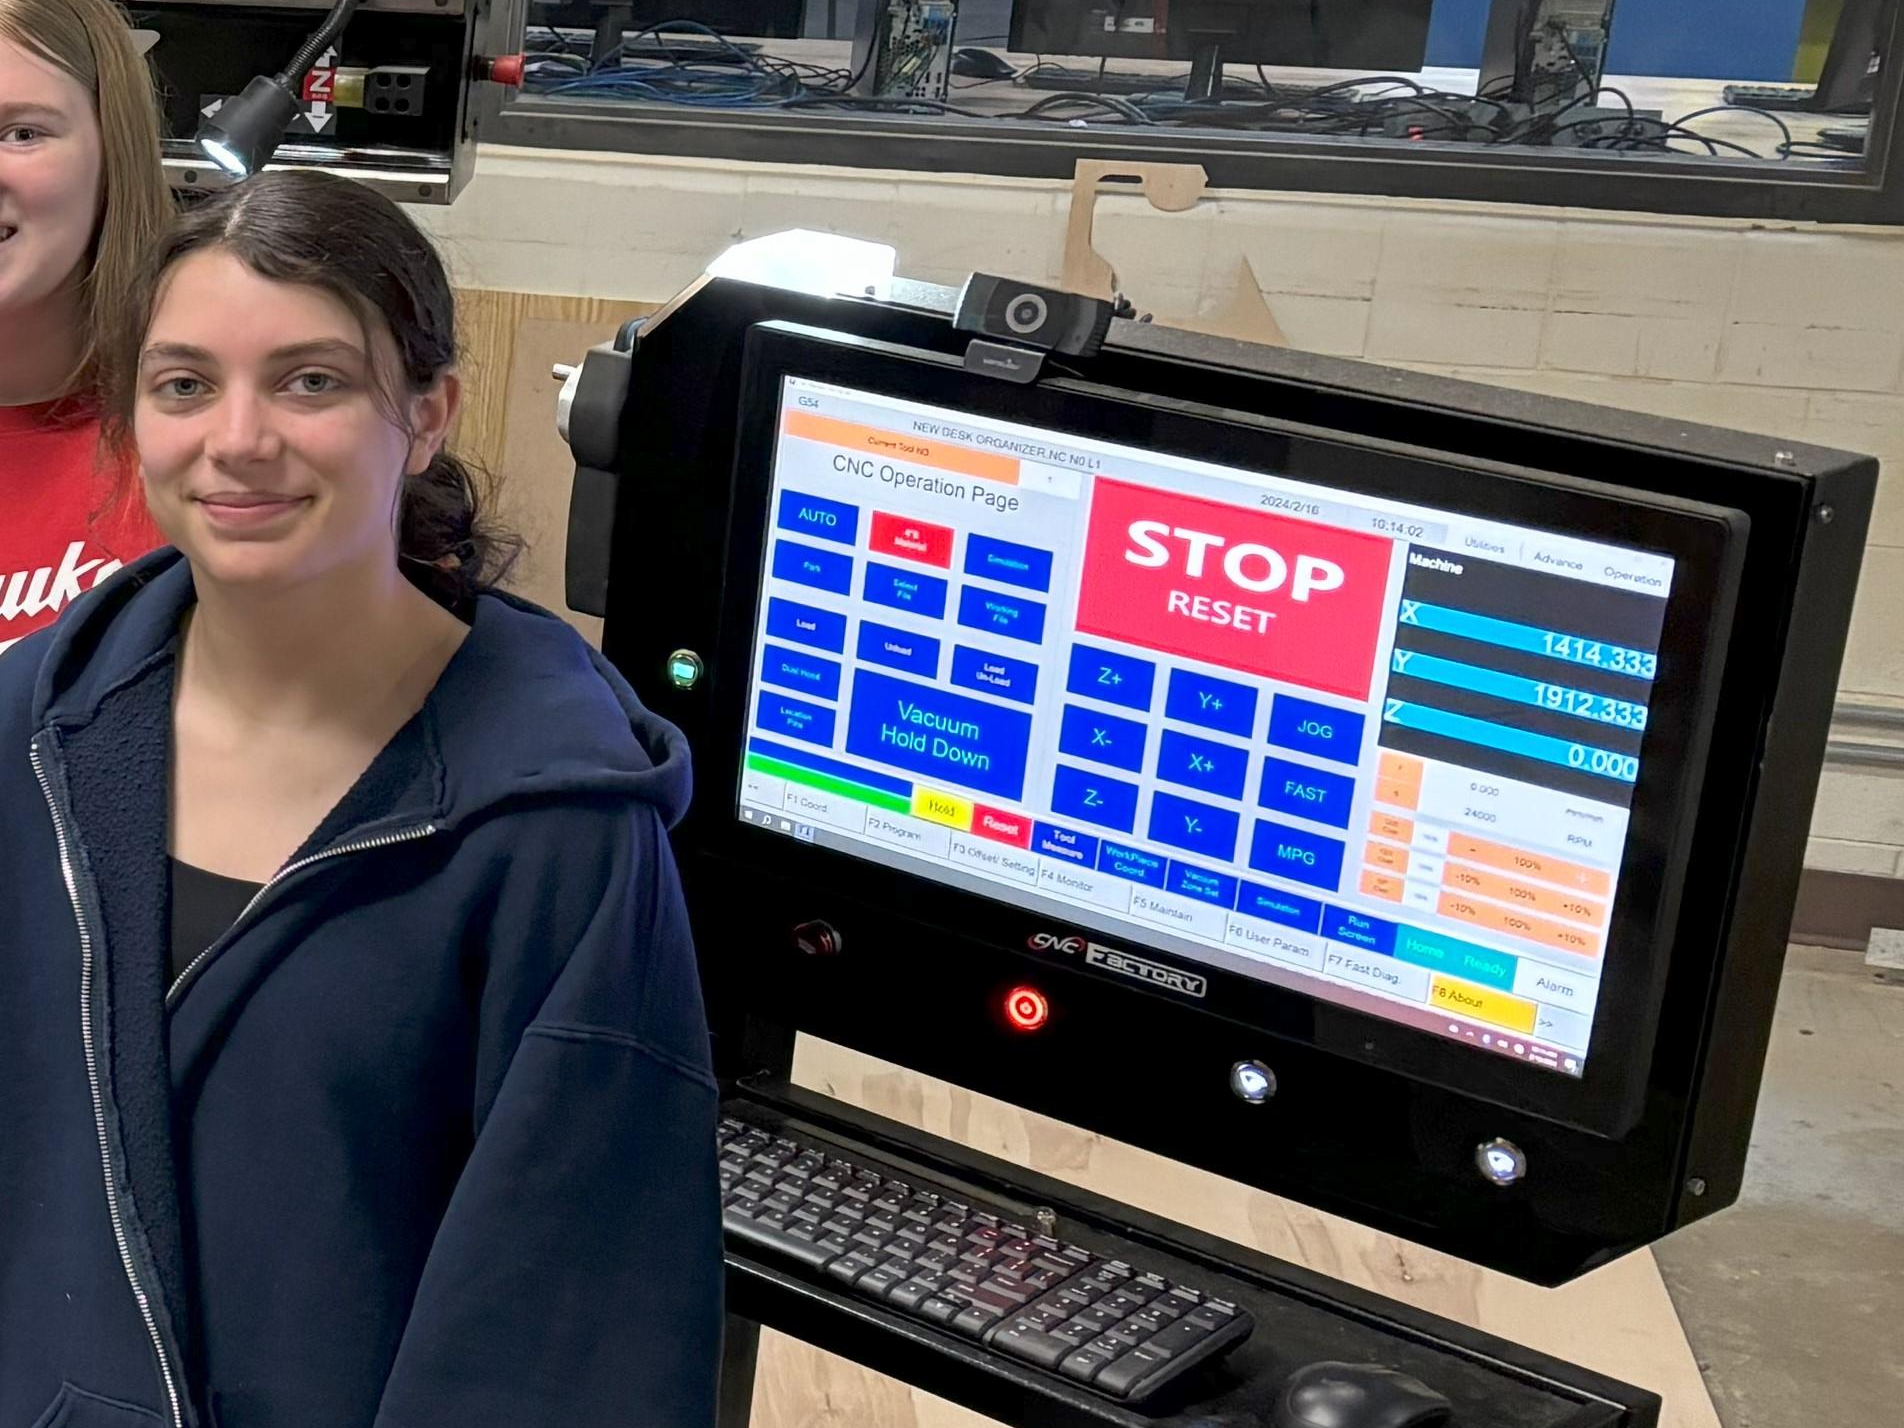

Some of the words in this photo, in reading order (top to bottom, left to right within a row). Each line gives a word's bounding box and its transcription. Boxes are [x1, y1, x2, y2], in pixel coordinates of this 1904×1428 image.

[798, 395, 819, 409] G54
[913, 420, 939, 436] NEW
[942, 427, 973, 443] DESK
[833, 454, 873, 478] CNC
[880, 465, 965, 499] Operation
[972, 486, 1019, 512] Page
[798, 507, 837, 526] AUTO
[1260, 494, 1319, 516] 2024/2/16
[1372, 517, 1424, 539] 10:14:02
[1124, 519, 1345, 602] STOP
[1409, 551, 1463, 576] Machine
[1534, 551, 1583, 571] Advance
[1604, 566, 1662, 588] Operation
[1167, 589, 1278, 635] RESET
[1400, 599, 1418, 623] X
[1543, 632, 1656, 675] 1414.333
[1098, 667, 1122, 685] Z+
[1394, 650, 1411, 672] Y
[1534, 683, 1648, 727] 1912.333
[1199, 692, 1223, 710] Y+
[898, 700, 979, 740] Vacuum
[1297, 719, 1333, 739] JOG
[881, 723, 927, 752] Hold
[933, 739, 990, 771] Down
[1091, 727, 1113, 746] X-
[1384, 699, 1404, 722] Z
[1568, 744, 1639, 779] 0.000
[1188, 754, 1215, 772] X+
[1084, 788, 1104, 807] Z-
[1285, 781, 1326, 803] FAST
[869, 817, 881, 829] F2
[883, 821, 922, 841] Program
[983, 815, 1019, 837] Reset
[1184, 816, 1204, 834] Y-
[1053, 829, 1076, 845] Tool
[1278, 843, 1315, 866] MPG
[1002, 856, 1036, 877] Setting
[1041, 868, 1054, 880] F4
[1057, 874, 1094, 892] Monitor
[1133, 896, 1147, 908] F5
[1150, 901, 1193, 922] Maintain
[1348, 914, 1370, 930] Run
[1030, 932, 1084, 956] CNC
[1246, 929, 1271, 946] User
[1273, 937, 1310, 957] Param
[1338, 926, 1376, 945] Screen
[1328, 954, 1343, 967] F7
[1345, 959, 1370, 976] Fast
[1406, 937, 1445, 959] Home
[1464, 954, 1507, 977] Ready
[1536, 977, 1574, 997] Alarm
[1448, 990, 1484, 1009] About
